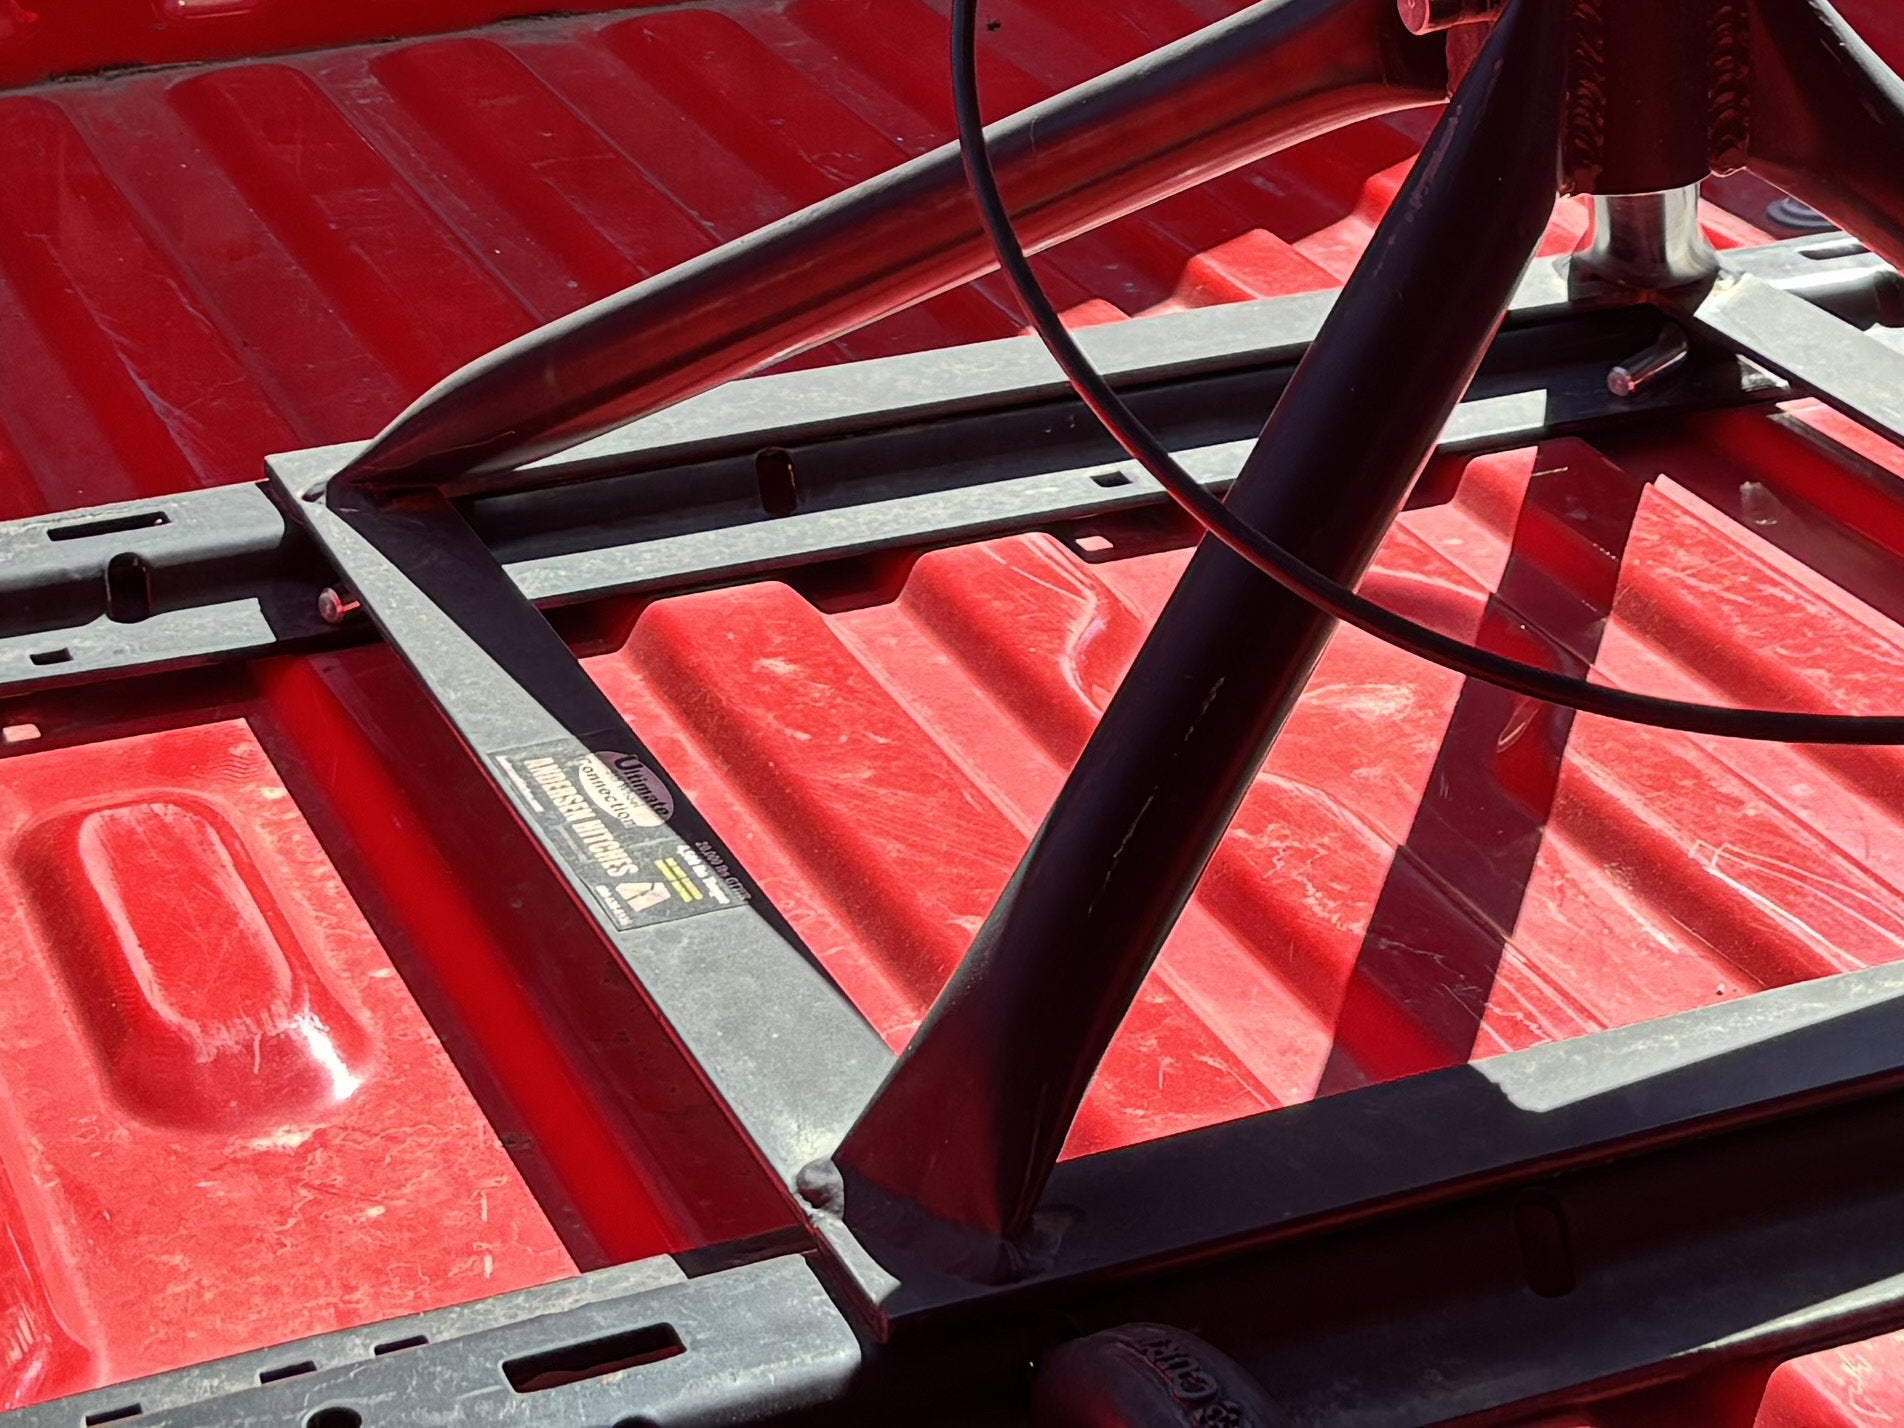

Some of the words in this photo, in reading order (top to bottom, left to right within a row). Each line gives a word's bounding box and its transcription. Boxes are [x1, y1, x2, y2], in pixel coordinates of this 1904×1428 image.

[524, 756, 596, 822] ANDERSEN
[614, 754, 669, 817] Ultimate
[572, 819, 639, 877] HITCHES
